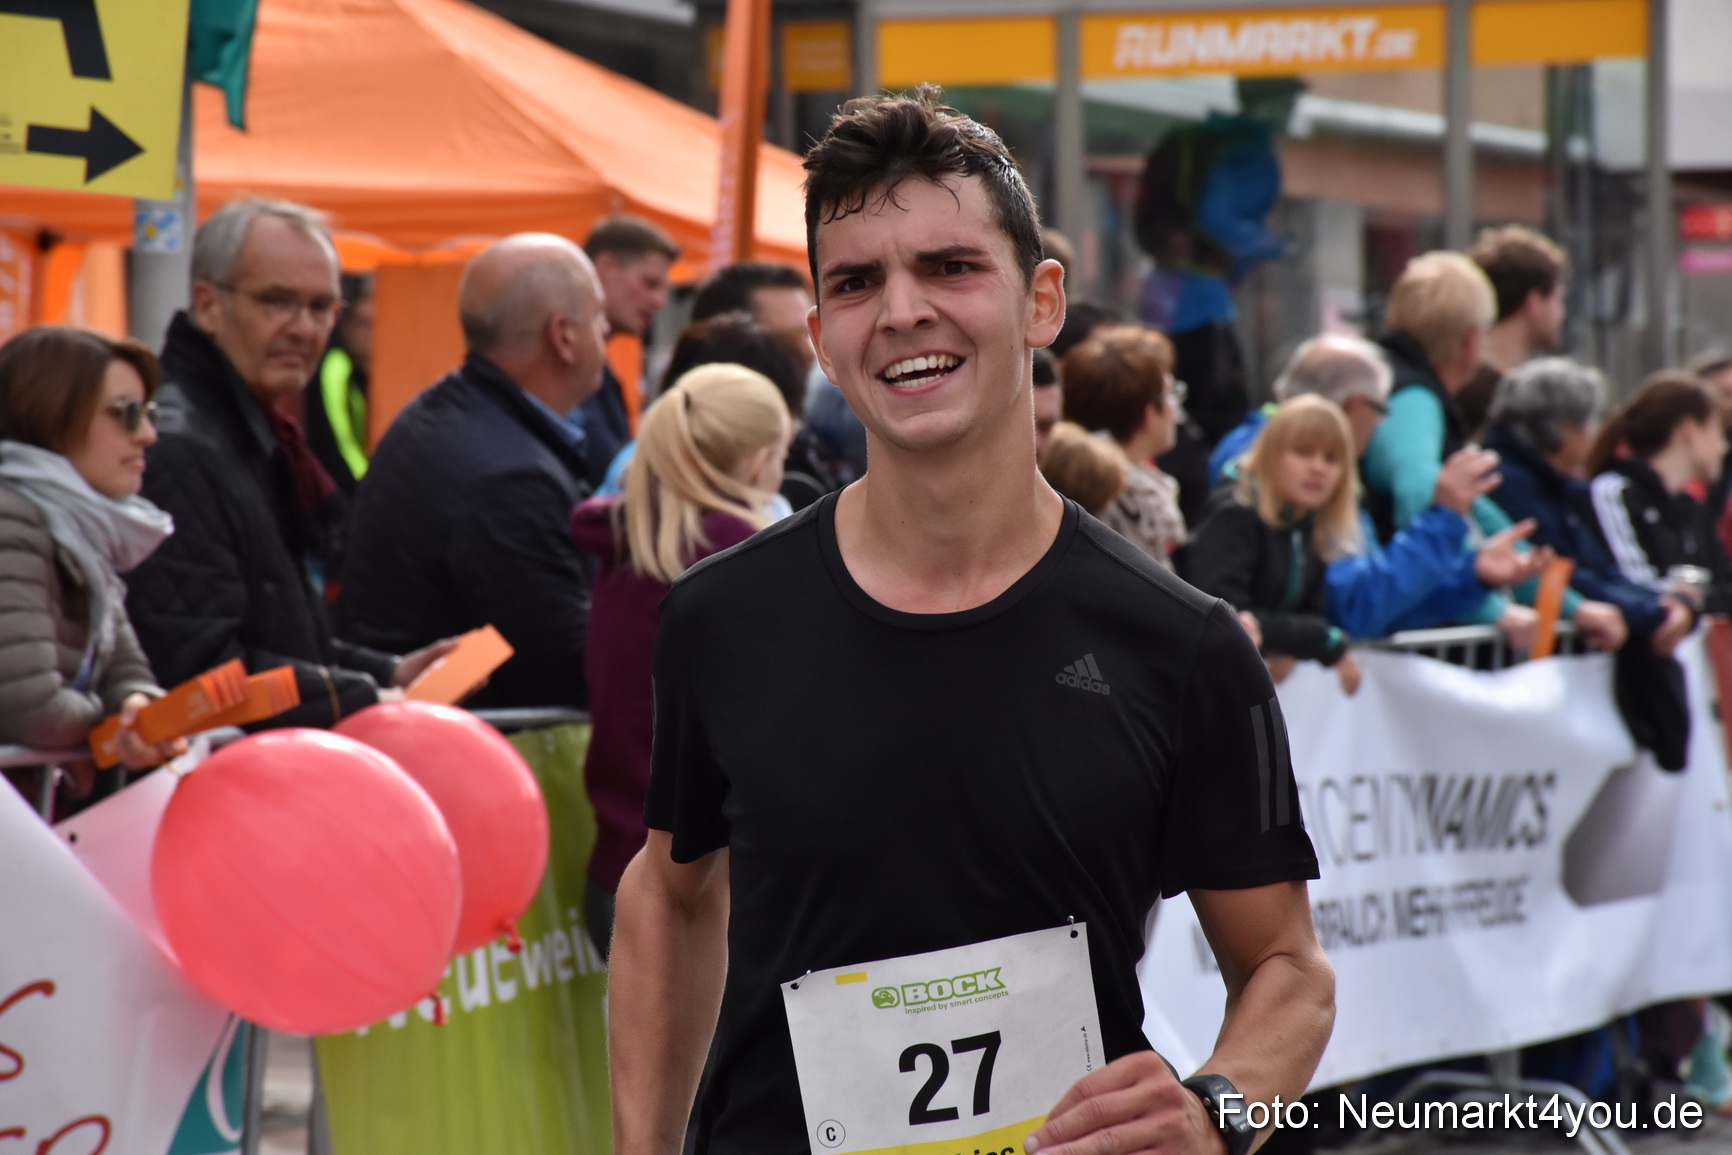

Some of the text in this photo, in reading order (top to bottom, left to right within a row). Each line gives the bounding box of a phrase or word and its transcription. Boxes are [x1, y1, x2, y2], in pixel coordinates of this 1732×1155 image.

[1055, 673, 1111, 695] adidas
[901, 967, 1006, 1006] BOCK
[905, 990, 1009, 1014] inspired by smart concepts
[899, 1030, 1002, 1126] 27
[825, 1126, 837, 1142] C
